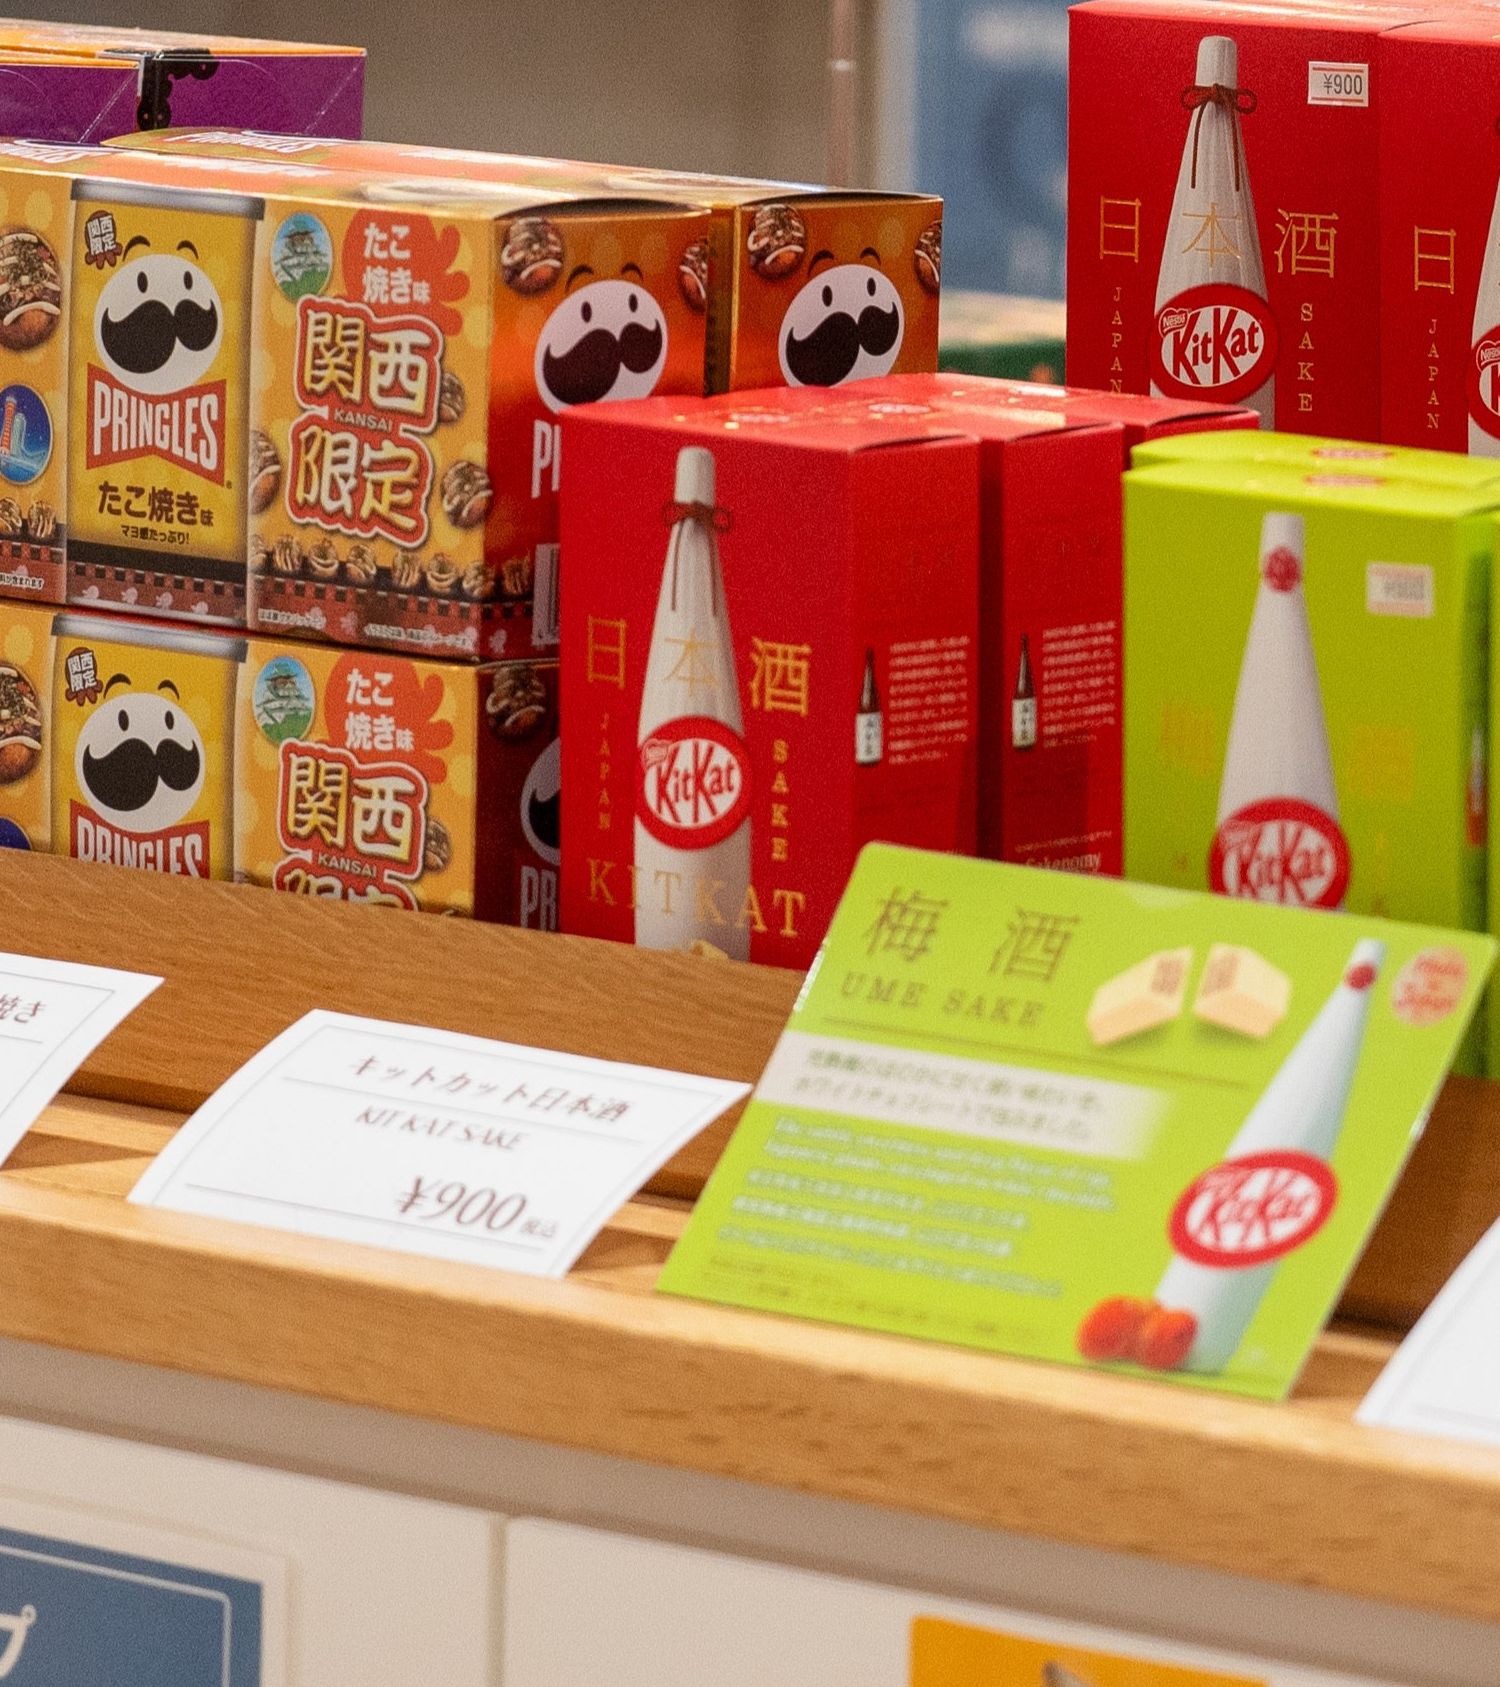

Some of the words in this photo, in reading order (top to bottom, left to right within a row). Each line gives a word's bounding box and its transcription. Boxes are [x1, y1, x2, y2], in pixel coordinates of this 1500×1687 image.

[1323, 73, 1363, 97] ¥900
[364, 223, 410, 259] たこ
[1099, 195, 1340, 278] 日本酒
[363, 271, 431, 306] 焼き味
[303, 310, 437, 416] 関西
[1171, 307, 1260, 386] KitKat
[1298, 303, 1313, 412] SAKE
[93, 380, 220, 473] PRINGLES
[335, 409, 393, 432] KANSAI
[99, 481, 214, 528] たこ焼き味
[296, 422, 422, 528] 限定
[347, 670, 394, 706] たこ
[586, 615, 812, 714] 日本酒
[344, 718, 414, 753] 焼き味
[287, 753, 421, 861] 関西
[654, 738, 740, 826] KitKat
[771, 740, 789, 861] SAKE
[317, 854, 377, 878] KANSAI
[588, 857, 805, 939] KITKAT
[862, 886, 1080, 985] 梅酒
[841, 972, 926, 1012] UME
[944, 990, 1045, 1028] SAKE
[349, 1054, 630, 1123] キットカット日本酒
[357, 1105, 402, 1129] KIT
[403, 1111, 453, 1138] KAT
[454, 1119, 528, 1152] SAKE
[398, 1175, 528, 1233] ¥900
